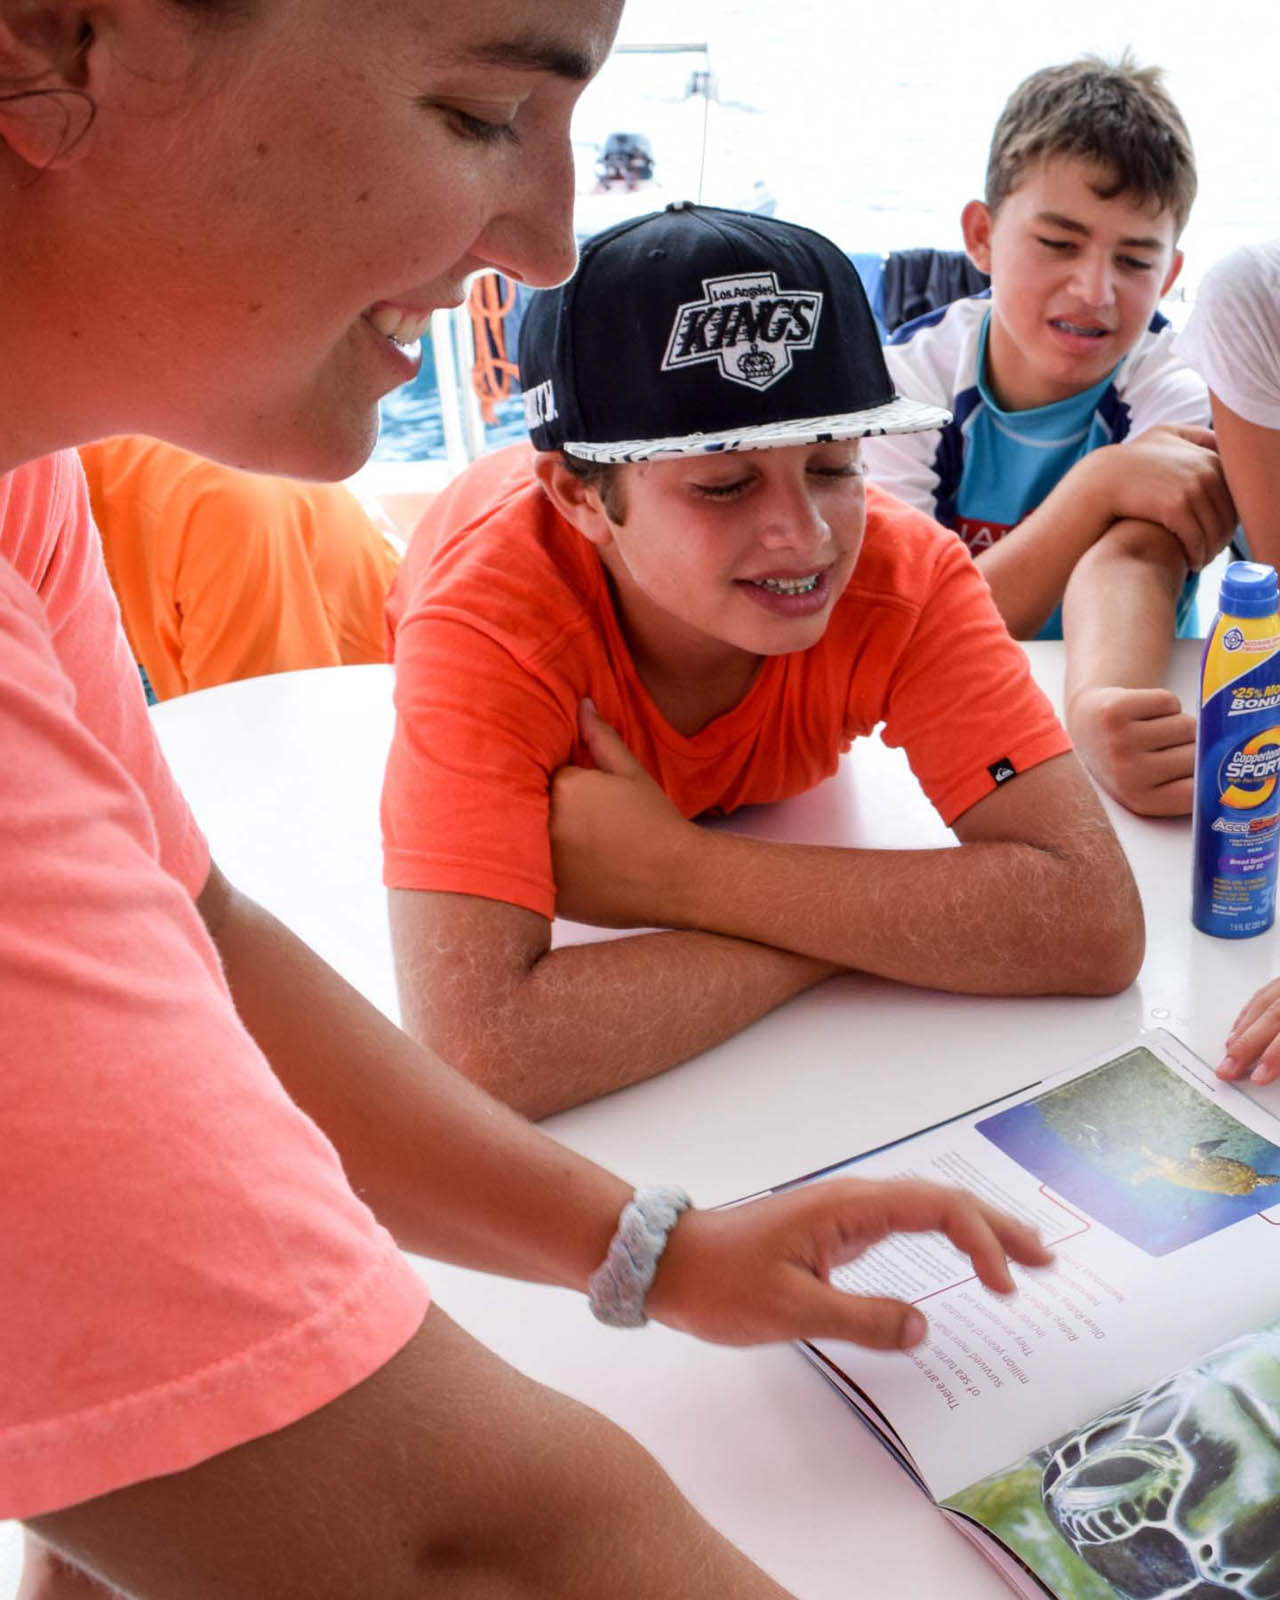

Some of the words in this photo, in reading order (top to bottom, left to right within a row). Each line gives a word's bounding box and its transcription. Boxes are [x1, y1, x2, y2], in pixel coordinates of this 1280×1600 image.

[713, 289, 732, 301] Los
[735, 284, 774, 299] Angeles
[675, 299, 815, 357] KINGS
[1084, 1318, 1106, 1340] Olive
[982, 1334, 1007, 1356] years
[1015, 1336, 1034, 1357] They
[930, 1345, 957, 1370] turtles
[924, 1368, 939, 1383] are
[955, 1368, 971, 1385] sea
[967, 1352, 1004, 1388] survived
[1002, 1354, 1031, 1384] million
[936, 1382, 960, 1410] There
[966, 1386, 981, 1396] of
